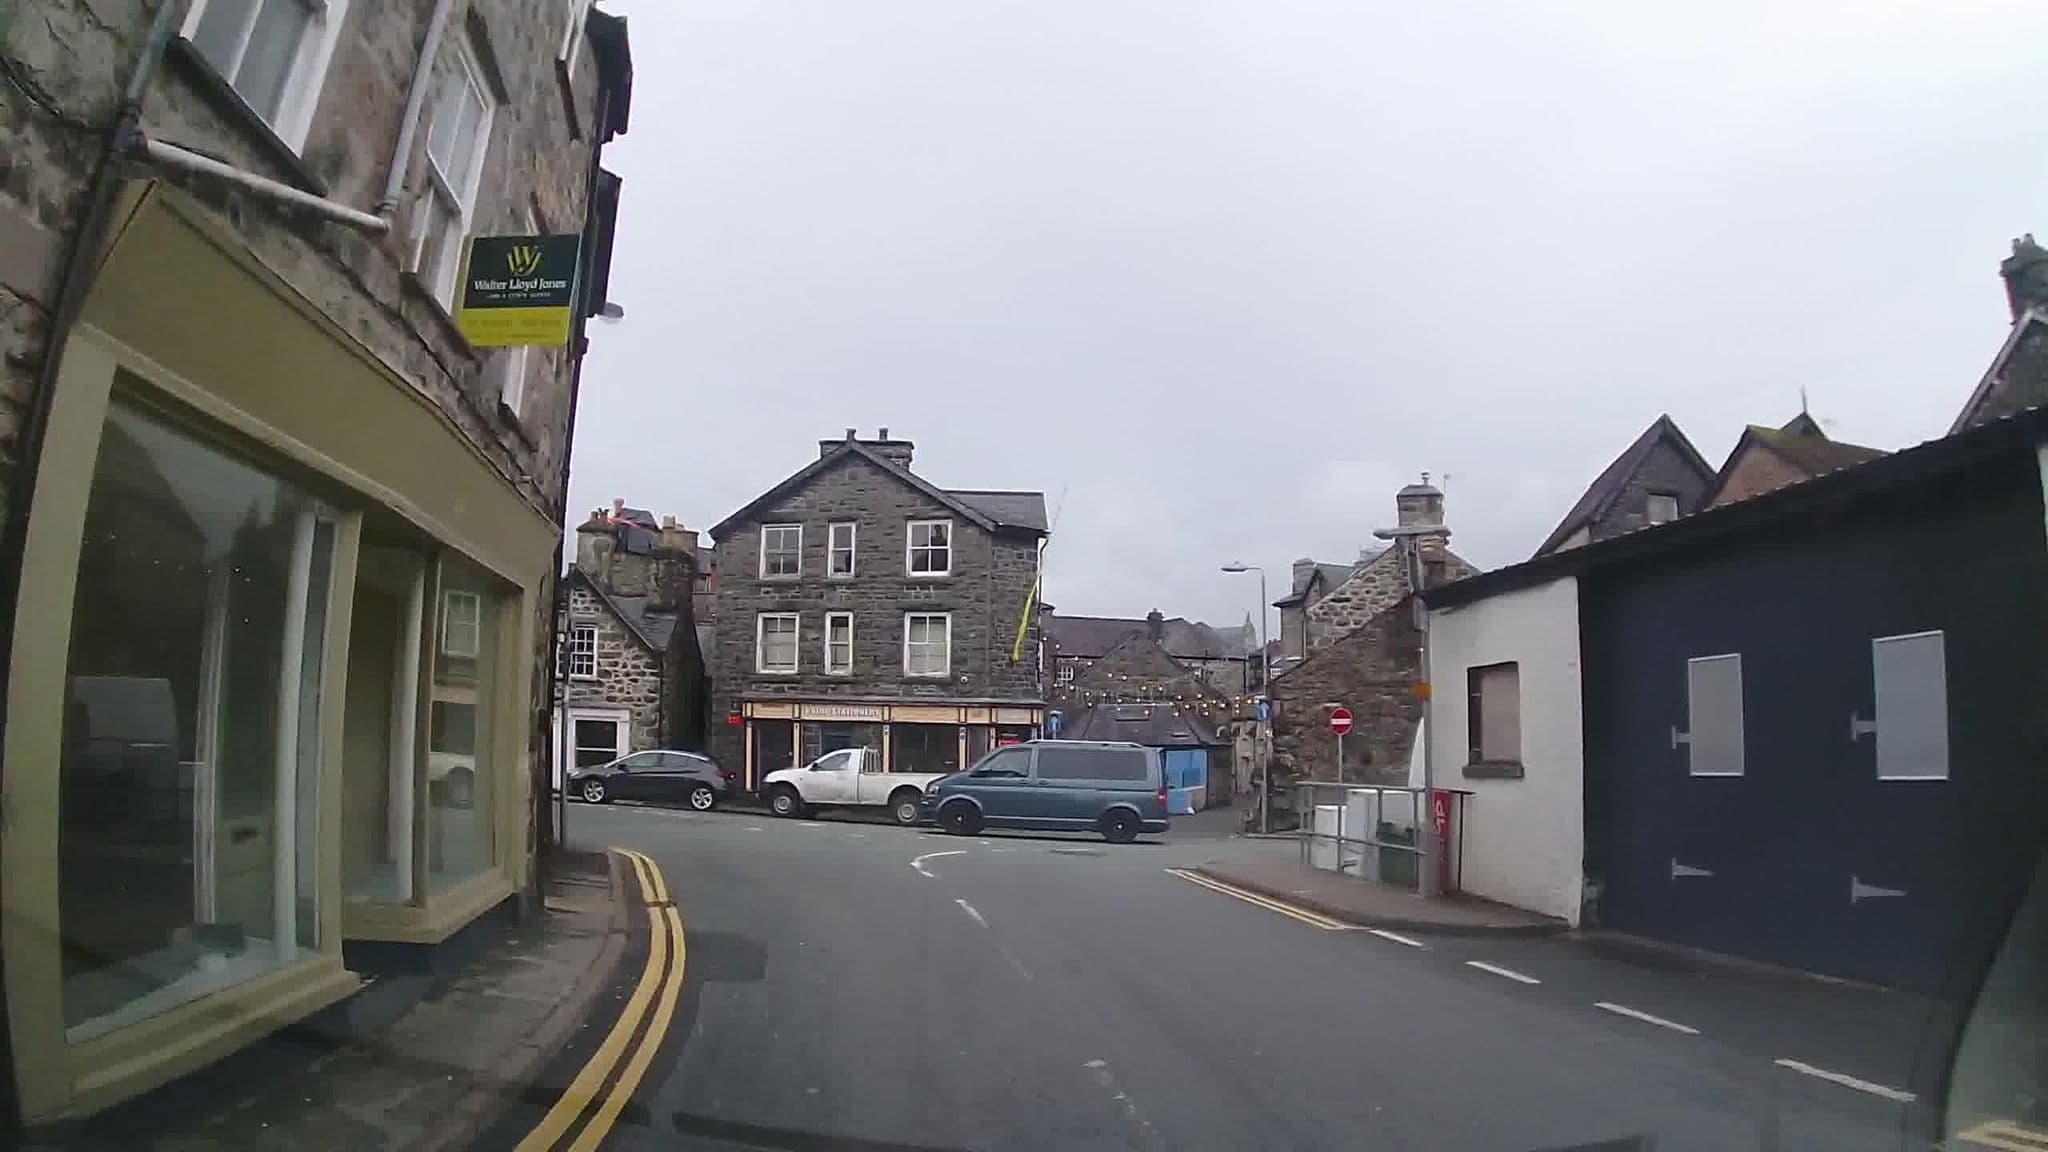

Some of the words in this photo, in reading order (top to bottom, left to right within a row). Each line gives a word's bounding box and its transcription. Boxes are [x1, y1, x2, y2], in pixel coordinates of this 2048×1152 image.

[474, 279, 508, 290] Walter
[508, 277, 537, 292] Lloyd
[538, 277, 567, 290] Jones
